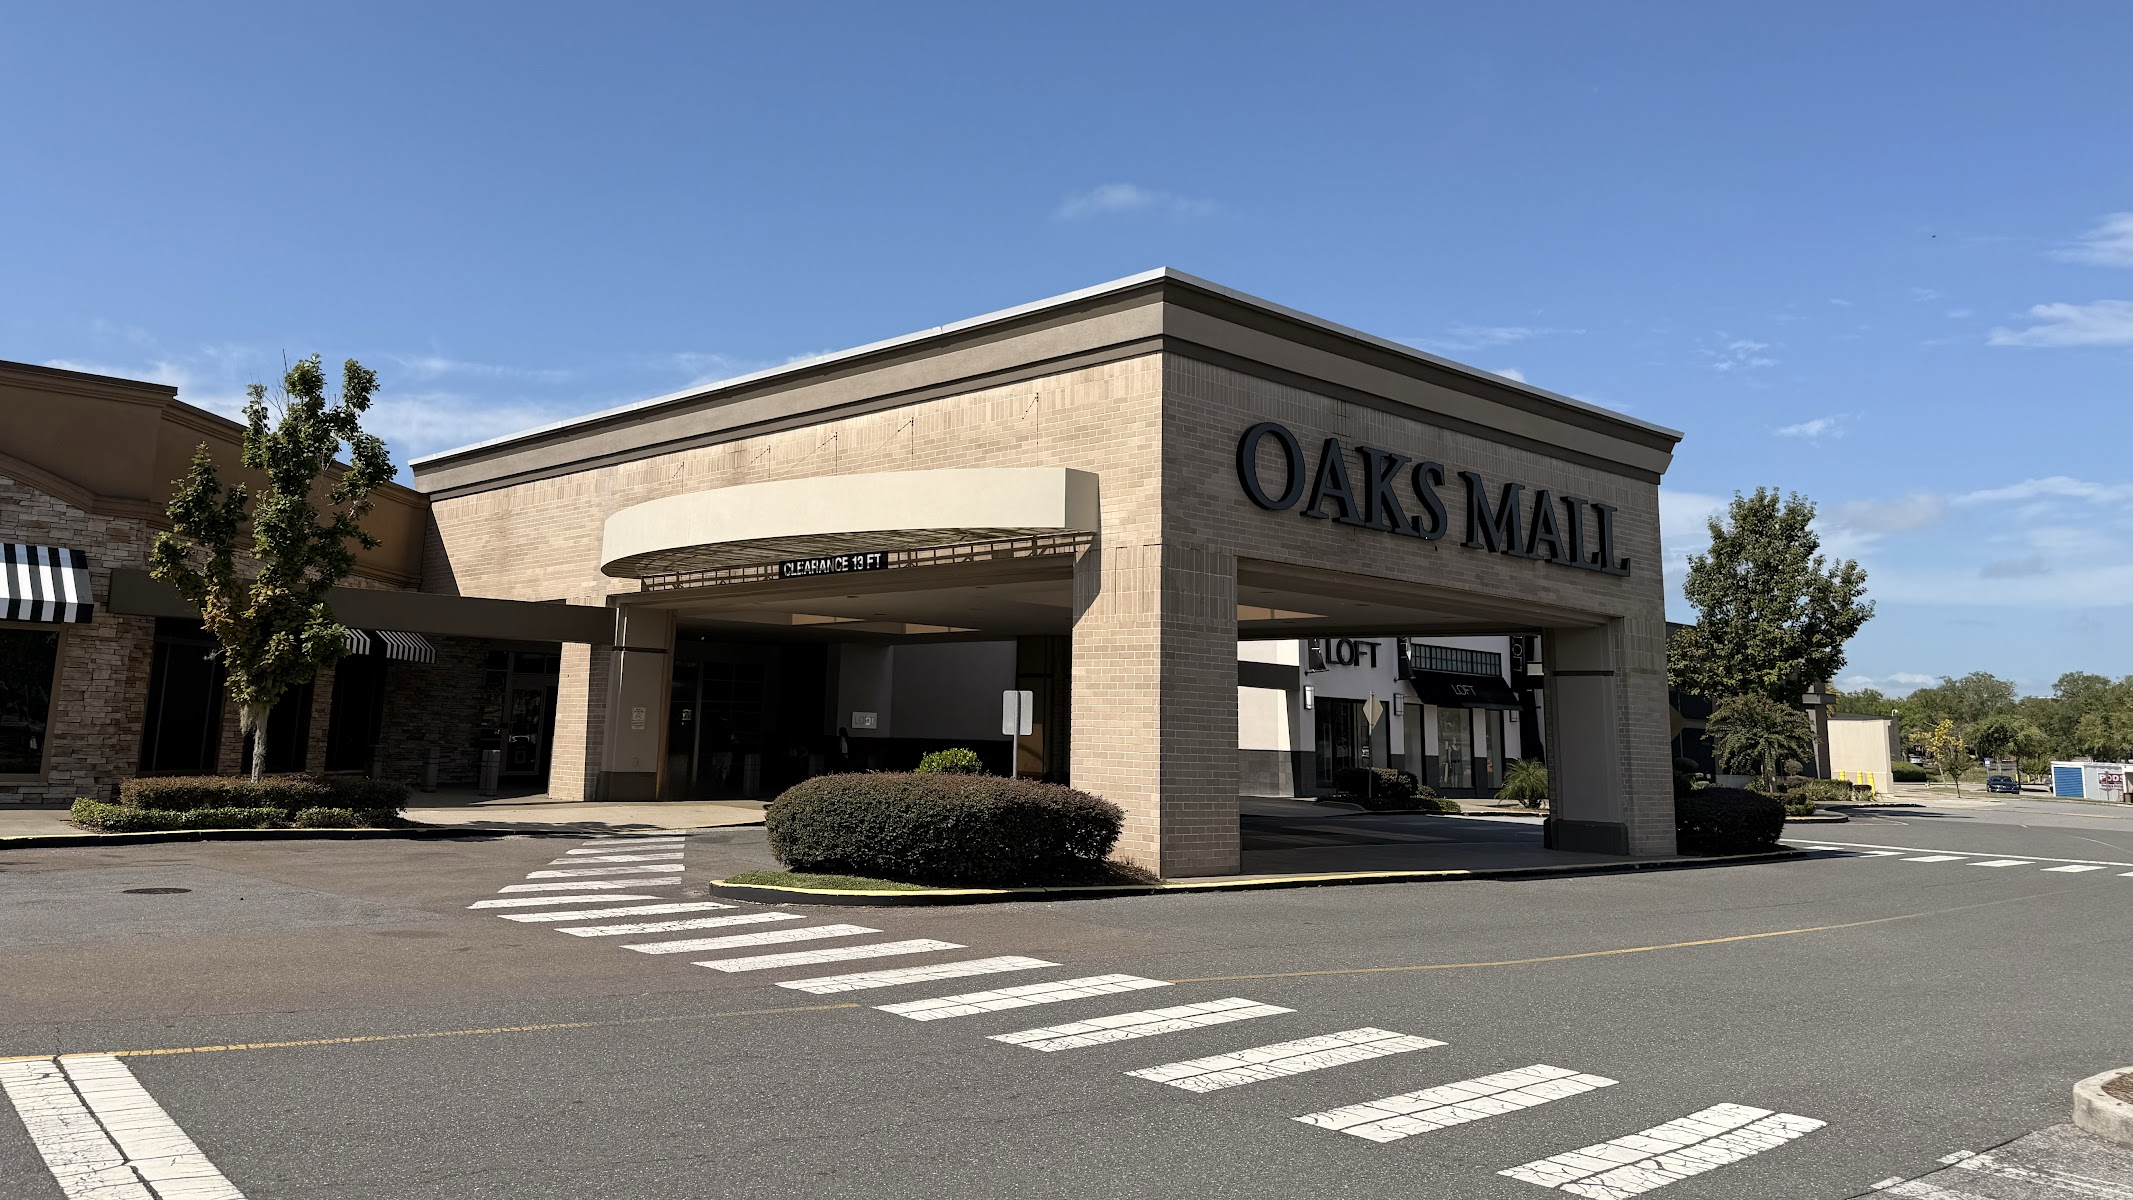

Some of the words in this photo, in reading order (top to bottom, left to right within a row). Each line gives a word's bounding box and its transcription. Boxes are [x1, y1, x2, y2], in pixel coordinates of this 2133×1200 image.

[1236, 422, 1448, 541] OAKS
[1458, 471, 1631, 577] MALL
[783, 557, 849, 576] CLEARANCE
[852, 556, 864, 570] 13
[866, 553, 882, 569] FT
[1325, 638, 1381, 668] LOFT
[1450, 684, 1477, 696] LOFT
